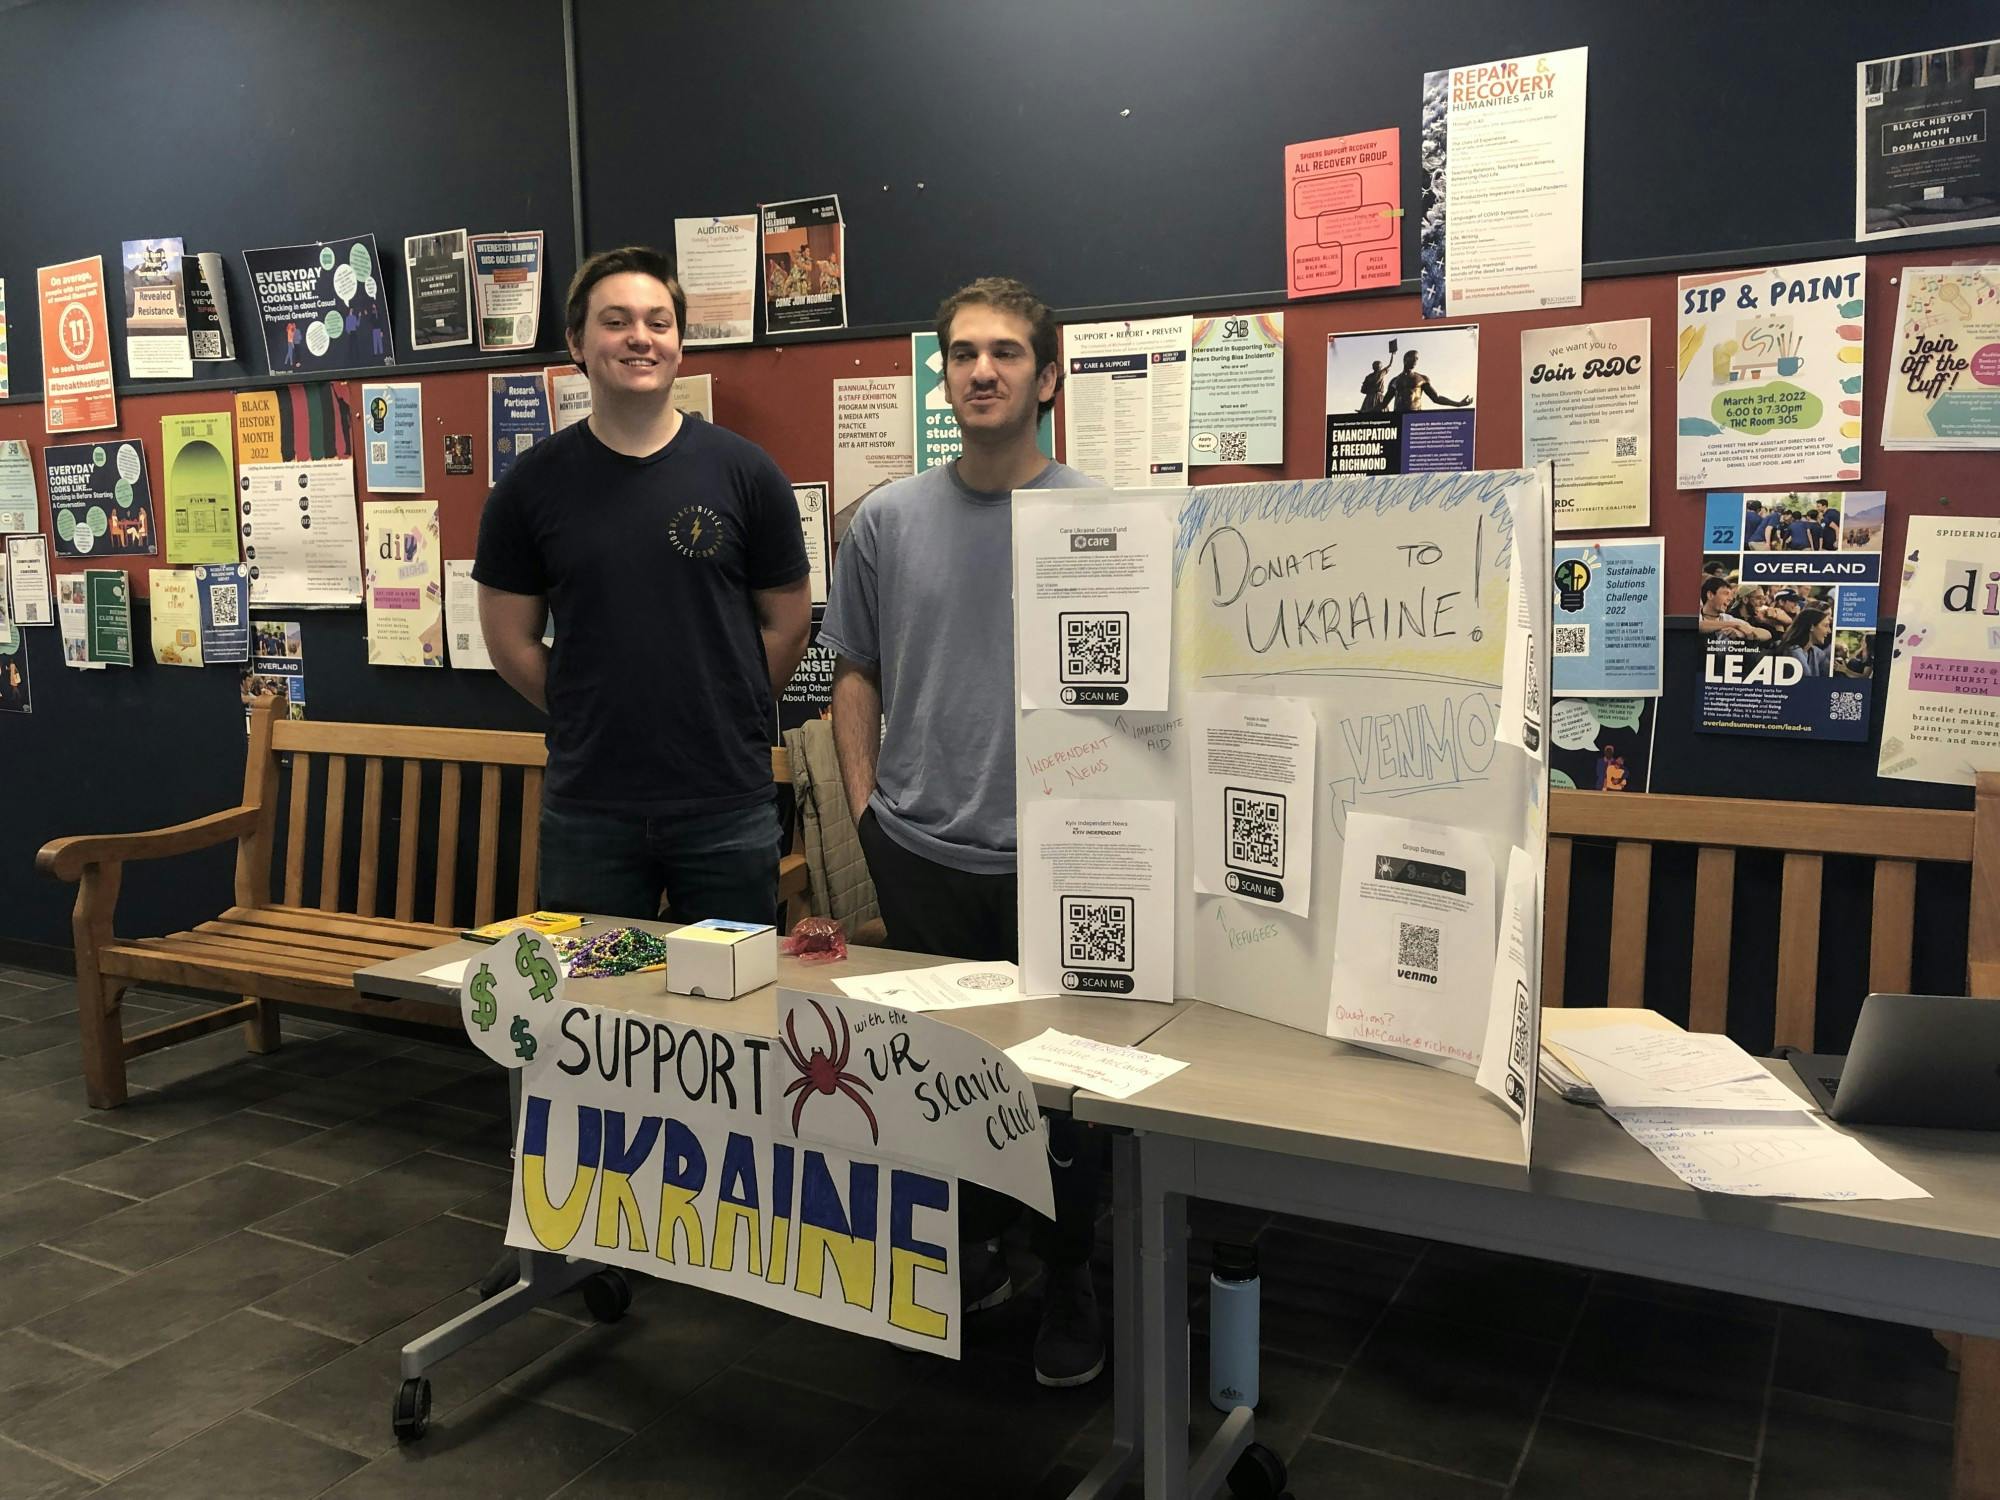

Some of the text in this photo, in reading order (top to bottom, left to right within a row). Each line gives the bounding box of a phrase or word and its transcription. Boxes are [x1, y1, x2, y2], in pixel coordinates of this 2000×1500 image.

[1454, 63, 1518, 86] REPAIR
[1454, 73, 1556, 103] RECOVERY
[1452, 90, 1554, 112] HUMANITIES AT UR
[1893, 113, 1974, 132] BLACK HISTORY
[1913, 127, 1950, 140] MONTH
[1892, 134, 1978, 153] DONATION DRIVE
[697, 225, 739, 235] AUDITIONS
[256, 267, 322, 283] EVERYDAY
[259, 280, 316, 295] CONSENT
[1684, 272, 1861, 314] SIP & PAINT
[140, 291, 171, 301] Revealed
[261, 292, 319, 304] LOOKS LIKE...
[138, 306, 174, 315] Resistance
[263, 298, 336, 313] Checking about Casual
[265, 311, 318, 323] Physical Greetings
[69, 319, 85, 342] 11
[1074, 327, 1182, 341] SUPPORT REPORT PREVENT
[1222, 320, 1249, 338] SAB
[1549, 348, 1564, 356] We
[1566, 342, 1587, 352] want
[1590, 342, 1606, 351] you
[1909, 333, 1958, 355] Join
[1530, 355, 1641, 384] Join RDC
[1900, 354, 1969, 382] Off the
[509, 386, 535, 395] Research
[241, 399, 270, 412] BLACK
[504, 398, 539, 408] Participants
[1723, 396, 1754, 406] March
[1779, 392, 1806, 402] 2022
[1726, 404, 1802, 417] 6:00 to 7:30pm
[239, 413, 276, 428] HISTORY
[1730, 415, 1798, 428] THC Room 305
[242, 432, 274, 443] MONTH
[1332, 428, 1397, 442] EMANCIPATION
[250, 448, 269, 458] 2022
[1332, 443, 1383, 457] & FREEDOM:
[49, 464, 94, 475] EVERYDAY
[1331, 458, 1386, 471] A RICHMOND
[50, 474, 90, 486] CONSENT
[1555, 499, 1574, 507] RDC
[697, 505, 722, 527] RIFLE
[667, 530, 695, 558] COFFEE
[1087, 537, 1110, 546] care
[1712, 530, 1734, 544] 22
[1396, 540, 1443, 568] TO
[1606, 566, 1656, 576] Sustainable
[1754, 562, 1866, 574] OVERLAND
[1606, 580, 1645, 589] Solutions
[1606, 593, 1648, 603] Challenge
[1606, 606, 1626, 614] 2022
[258, 662, 298, 671] OVERLAND
[1705, 654, 1803, 686] LEAD
[1914, 672, 1988, 684] WHITEHURST
[1080, 692, 1104, 700] SCAN
[1955, 686, 1988, 694] ROOM
[1913, 713, 1955, 723] bracelet
[1131, 717, 1185, 740] IMMEDIATE
[1703, 720, 1812, 731] overlandsummers.com/lead-us
[1146, 737, 1172, 752] AID
[1339, 692, 1498, 784] VENMO
[1025, 735, 1115, 777] INDEPENDENT
[1065, 759, 1108, 786] NEWS
[1403, 843, 1445, 856] Group Donation
[1241, 880, 1276, 896] SCAN ME
[1228, 923, 1279, 949] REFUGEES
[1082, 978, 1124, 988] SCAN ME
[1397, 968, 1438, 984] venmo
[854, 1010, 908, 1033] with the
[557, 1006, 770, 1116] SUPPORT
[864, 1033, 930, 1081] UR
[521, 1094, 950, 1340] UKRAINE
